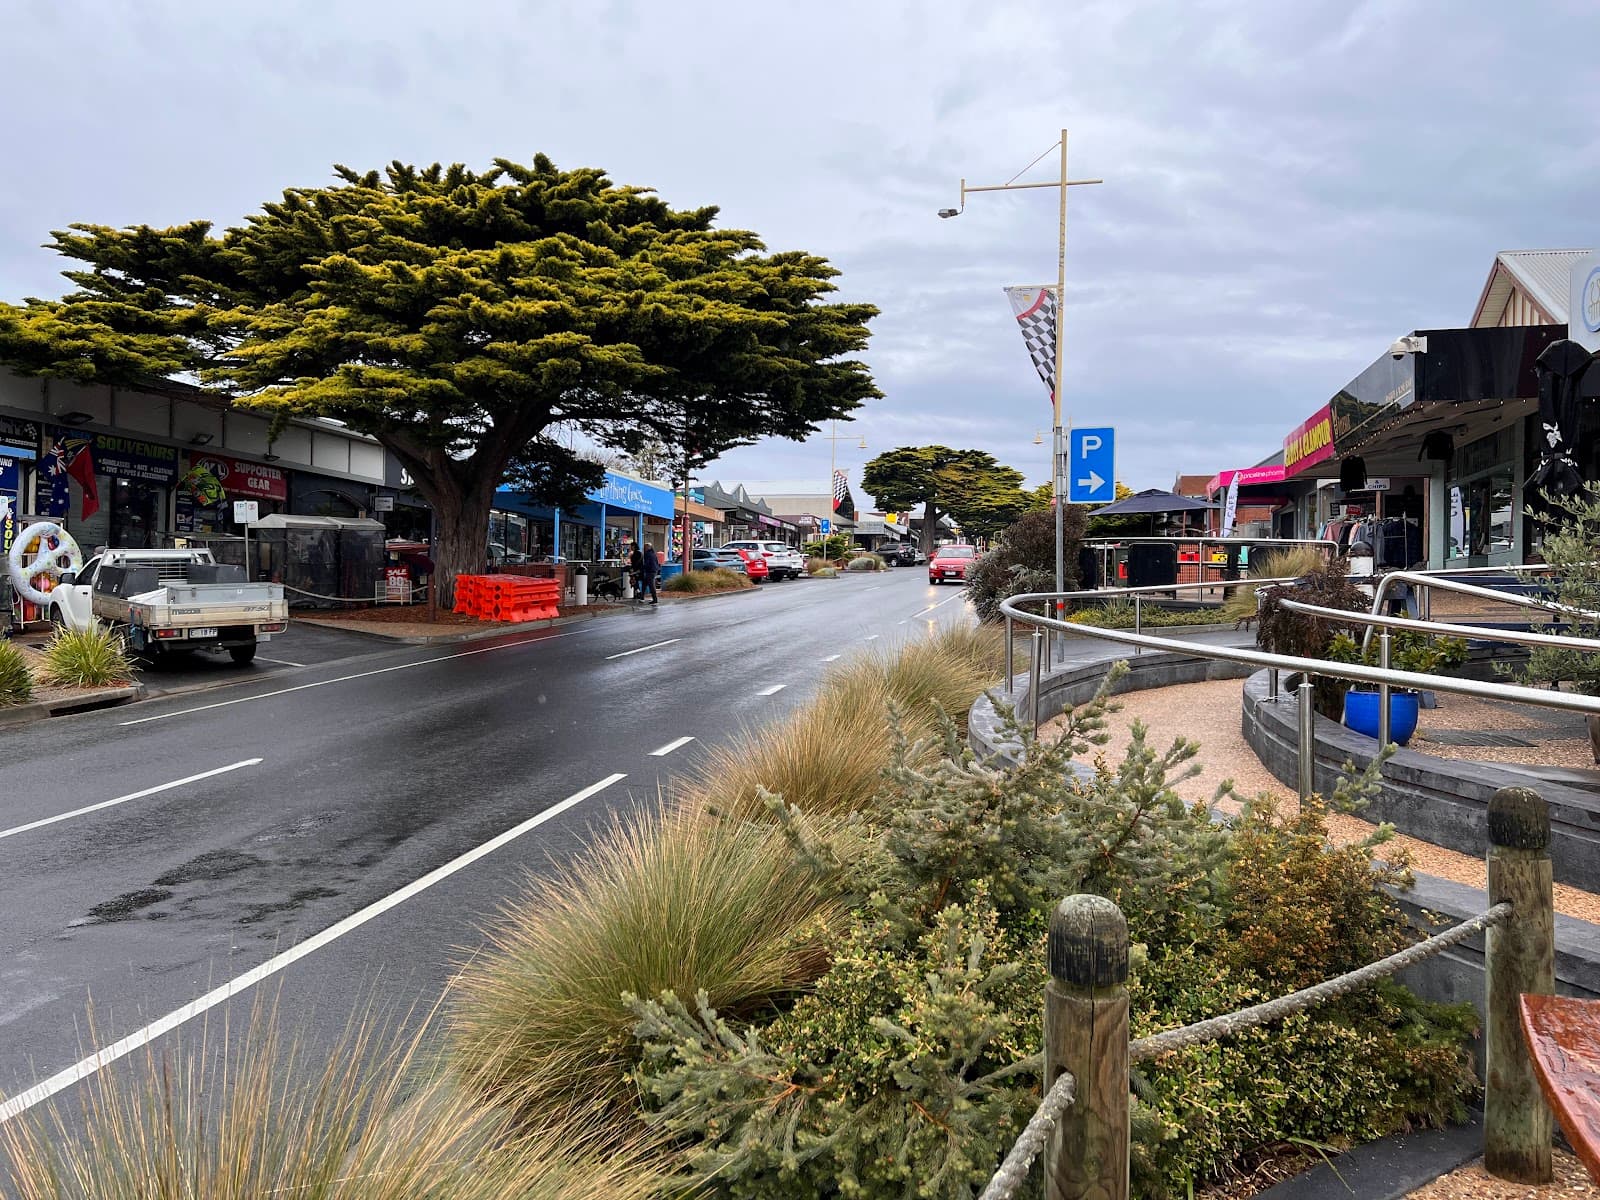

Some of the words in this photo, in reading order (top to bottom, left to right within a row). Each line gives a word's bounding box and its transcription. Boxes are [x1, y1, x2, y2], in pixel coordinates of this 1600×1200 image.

[97, 435, 177, 461] SOUVENIRS
[1082, 435, 1102, 459] P
[1303, 418, 1331, 457] GLAMOUR
[234, 462, 281, 480] SUPPORTER
[248, 478, 270, 491] GEAR
[1227, 496, 1235, 518] CAFE
[386, 568, 409, 576] SALE
